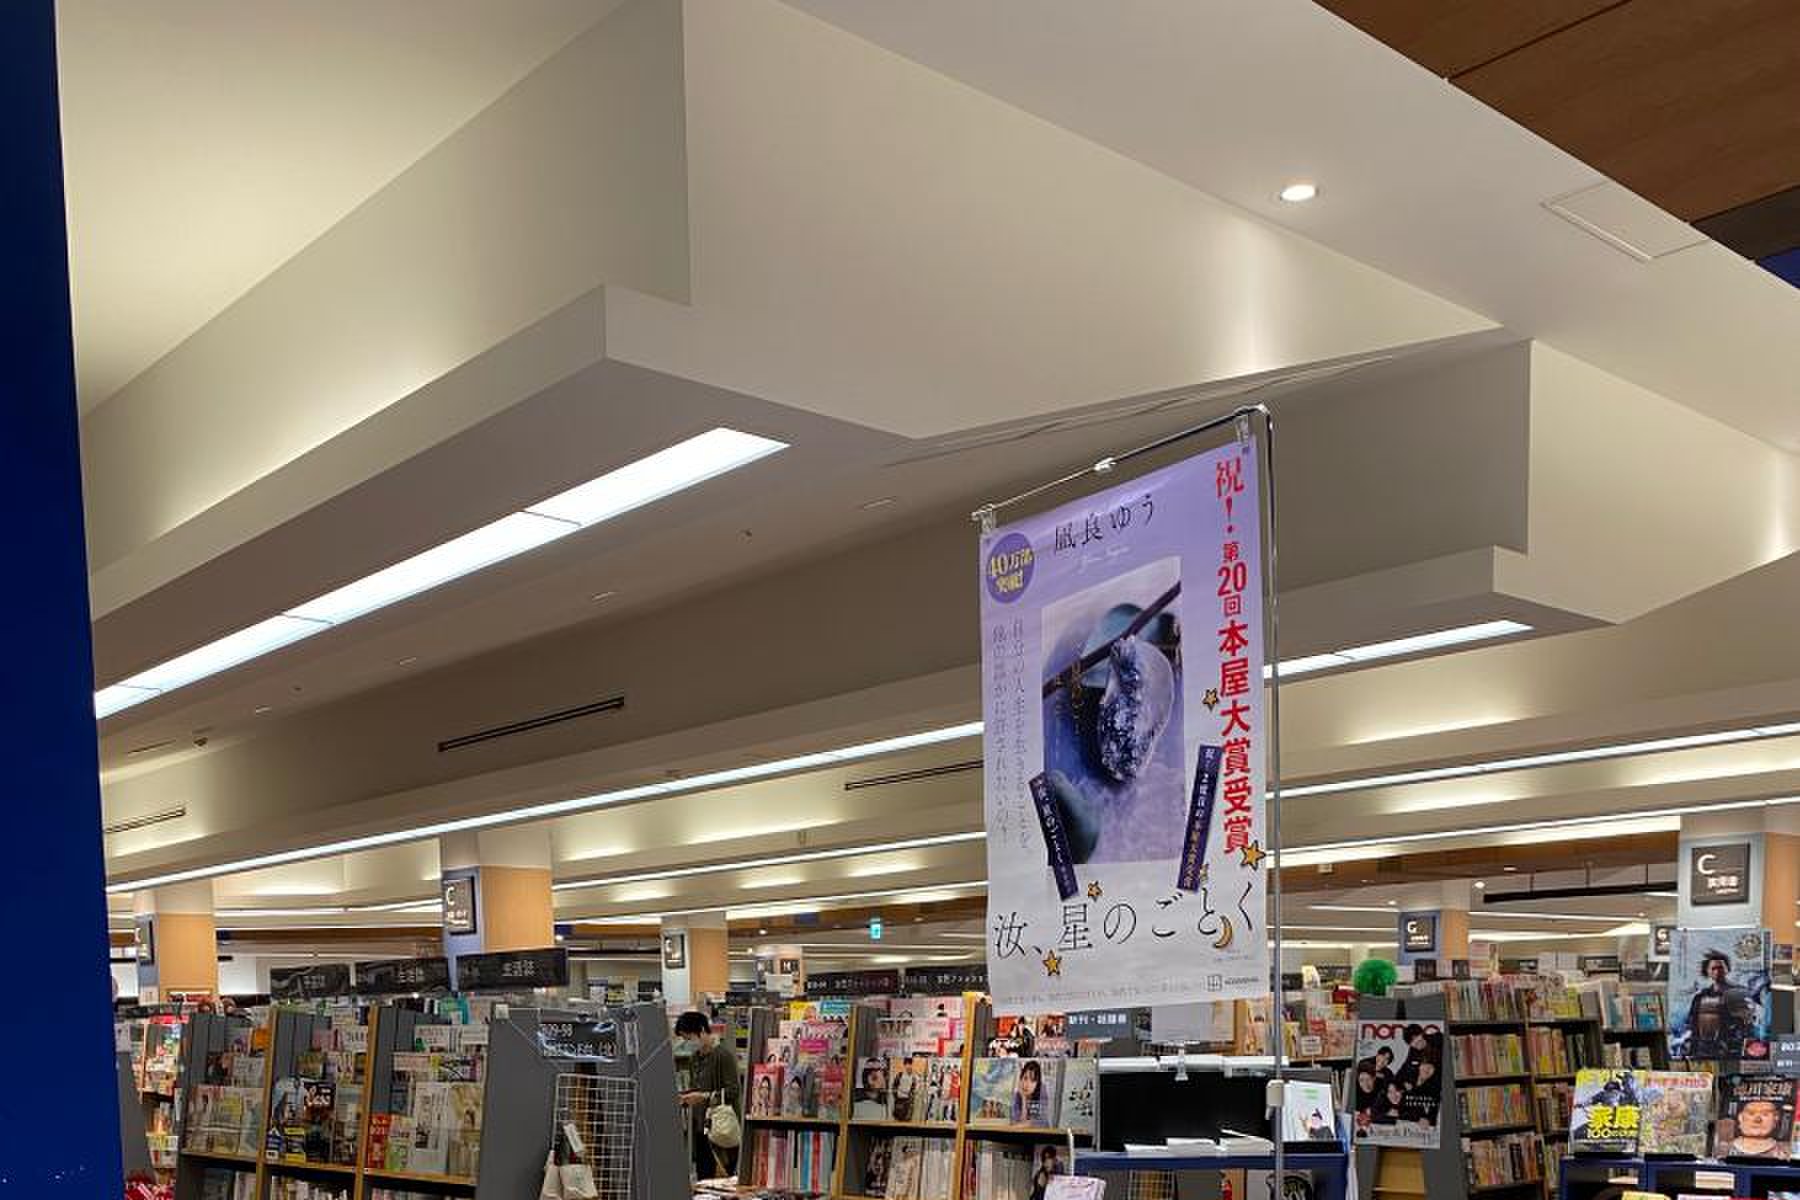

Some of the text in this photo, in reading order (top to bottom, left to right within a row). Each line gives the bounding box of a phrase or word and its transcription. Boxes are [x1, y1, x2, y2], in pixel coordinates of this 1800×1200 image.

[1697, 853, 1717, 875] C
[993, 880, 1253, 960] 汝、星のごとく
[1586, 1103, 1641, 1130] 家康
